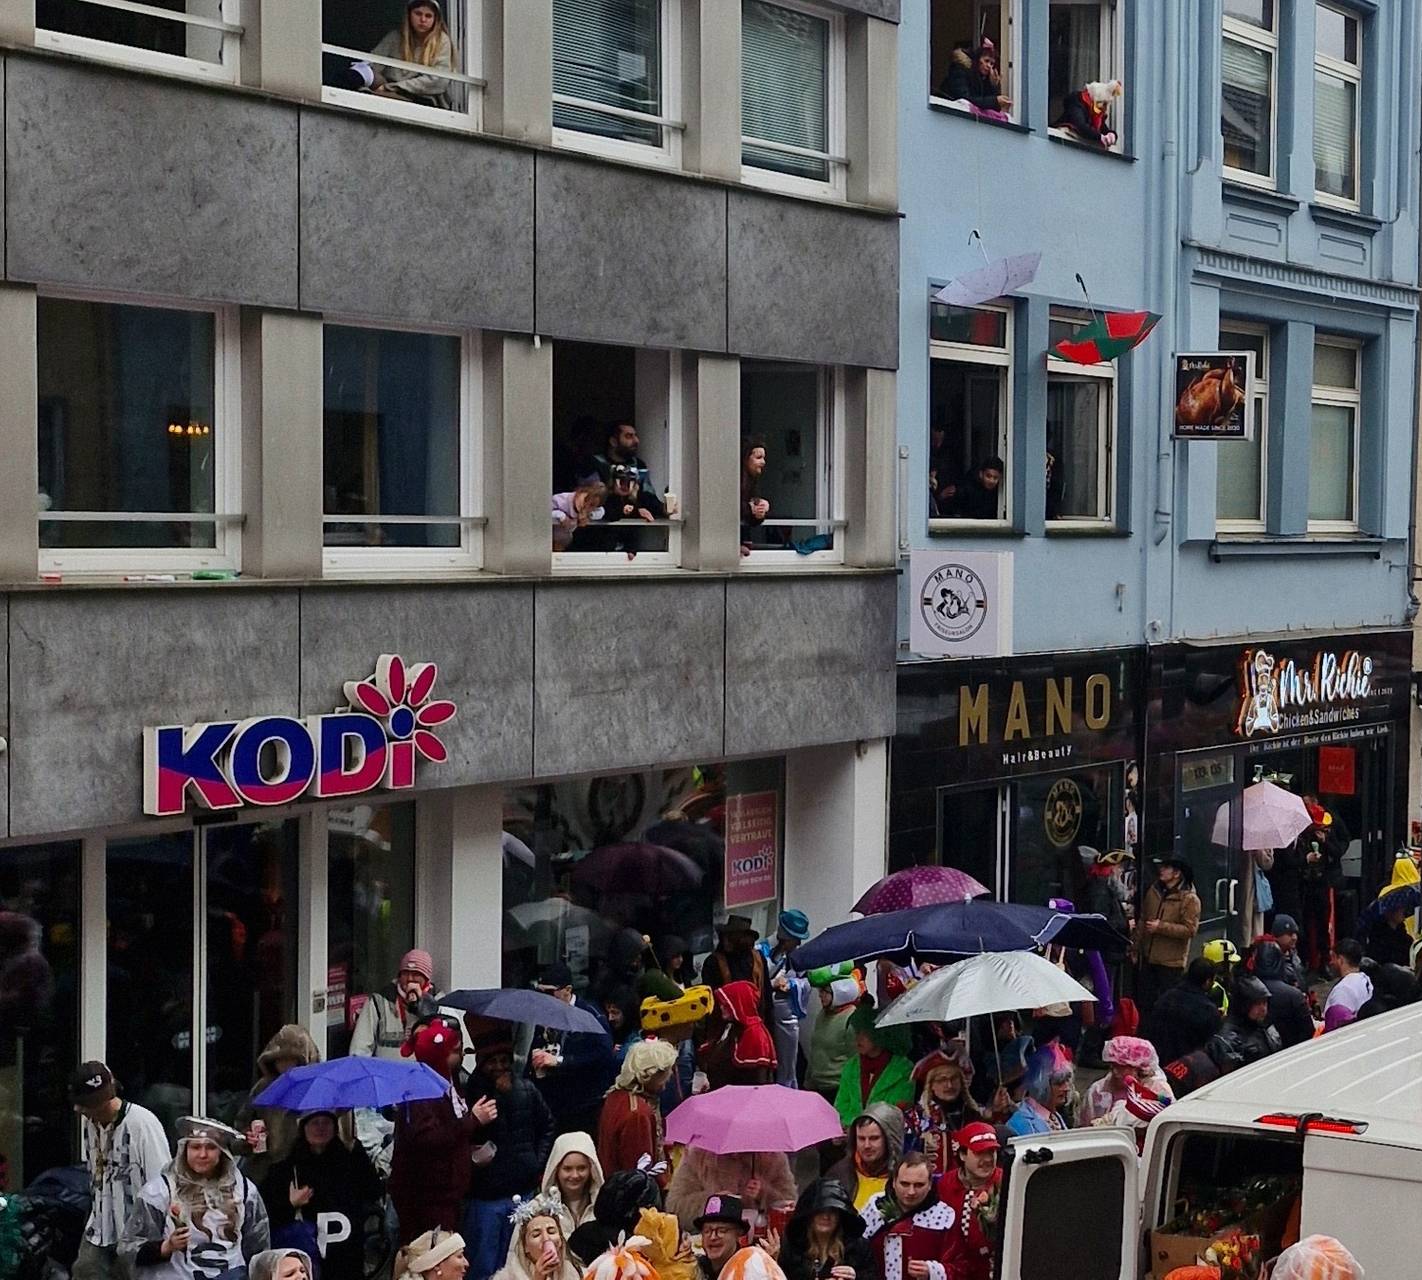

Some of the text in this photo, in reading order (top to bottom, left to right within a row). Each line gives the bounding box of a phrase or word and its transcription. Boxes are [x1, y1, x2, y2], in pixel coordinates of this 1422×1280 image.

[934, 568, 975, 584] MANO
[958, 673, 1111, 747] MANO
[1002, 744, 1073, 765] Hair&Beauty
